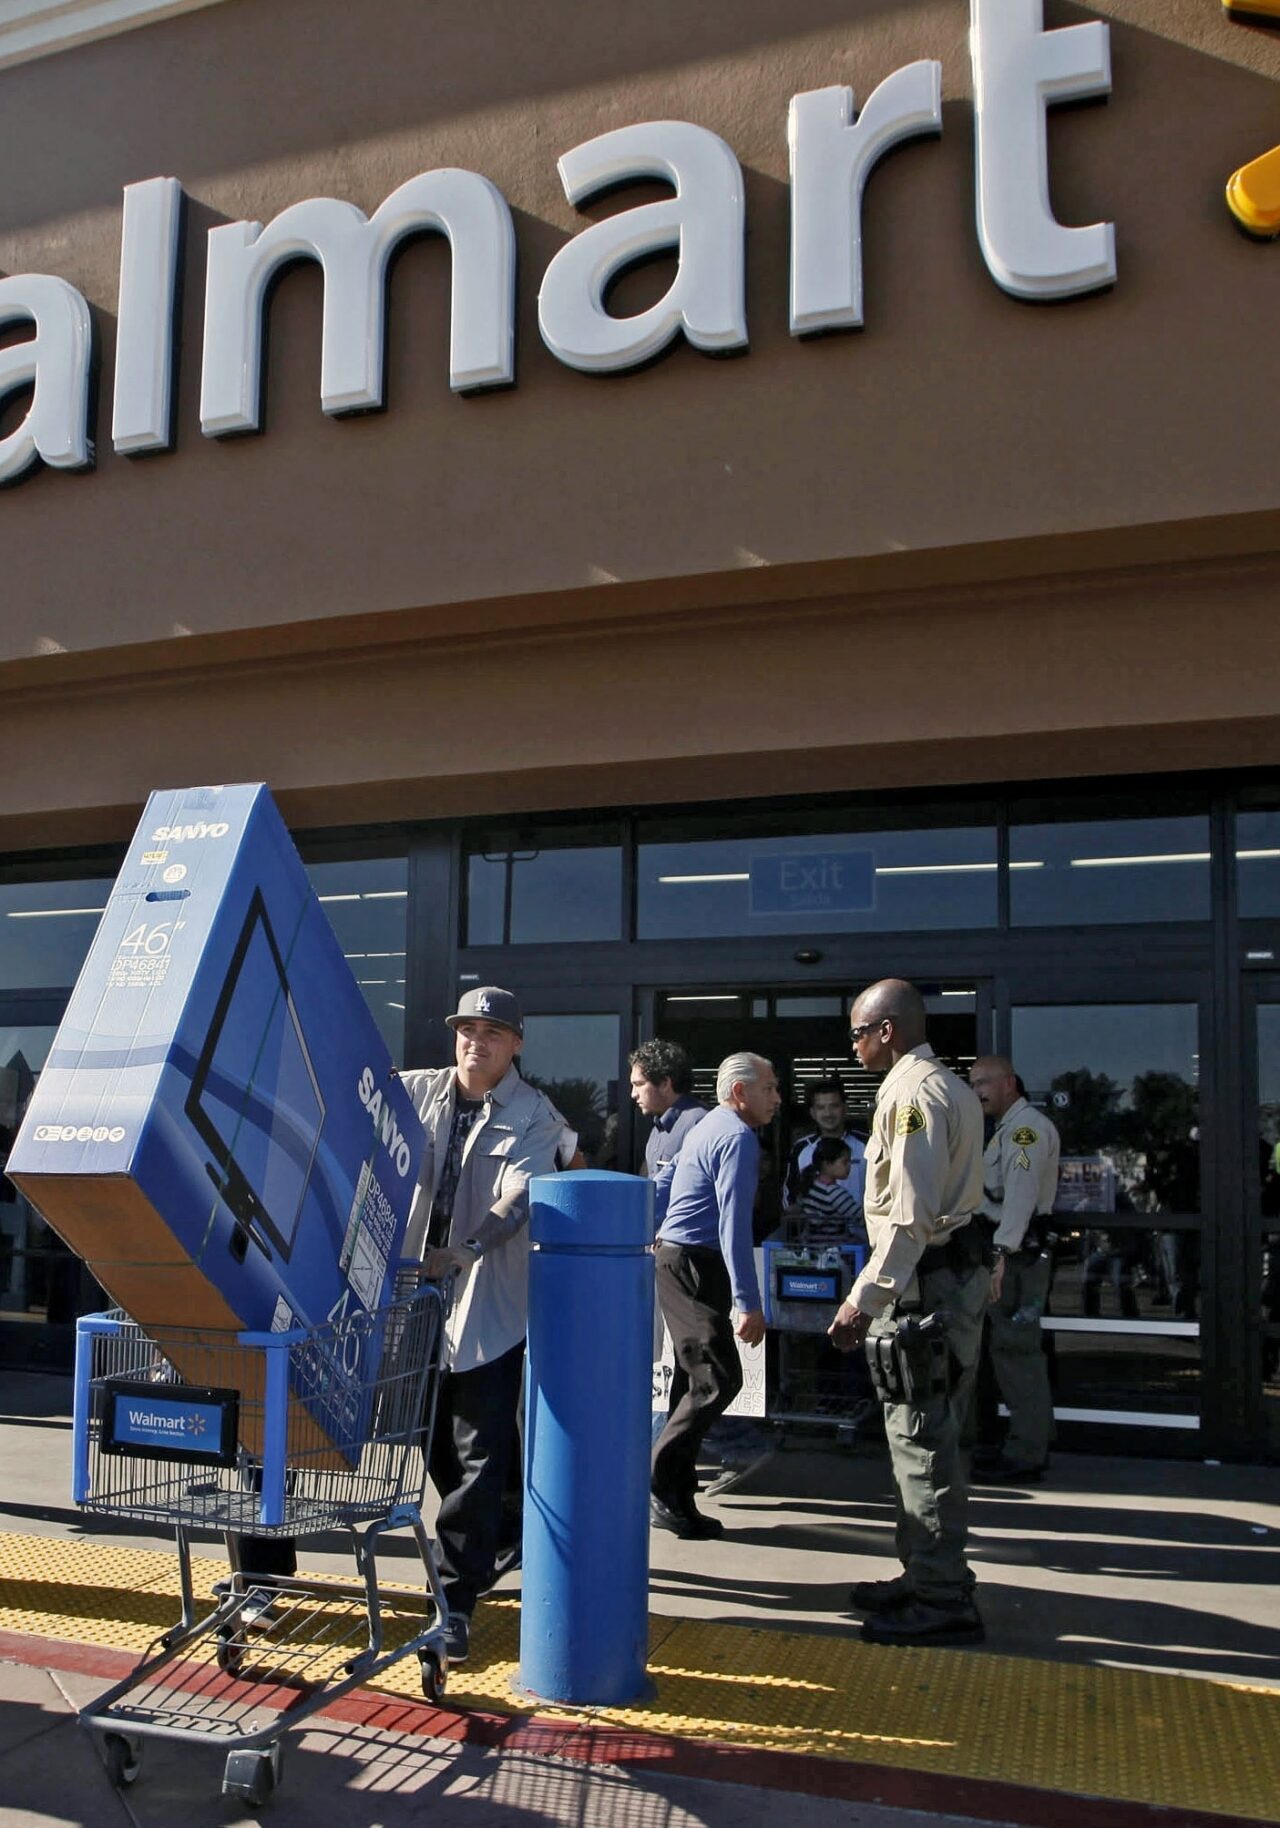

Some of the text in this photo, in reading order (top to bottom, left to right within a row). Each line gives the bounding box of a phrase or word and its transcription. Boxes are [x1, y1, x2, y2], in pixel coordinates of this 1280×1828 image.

[151, 820, 230, 844] SANYO
[780, 858, 844, 891] Exit
[357, 1066, 411, 1178] SANYO
[789, 1280, 818, 1290] Walmart
[129, 1411, 185, 1431] Walmart
